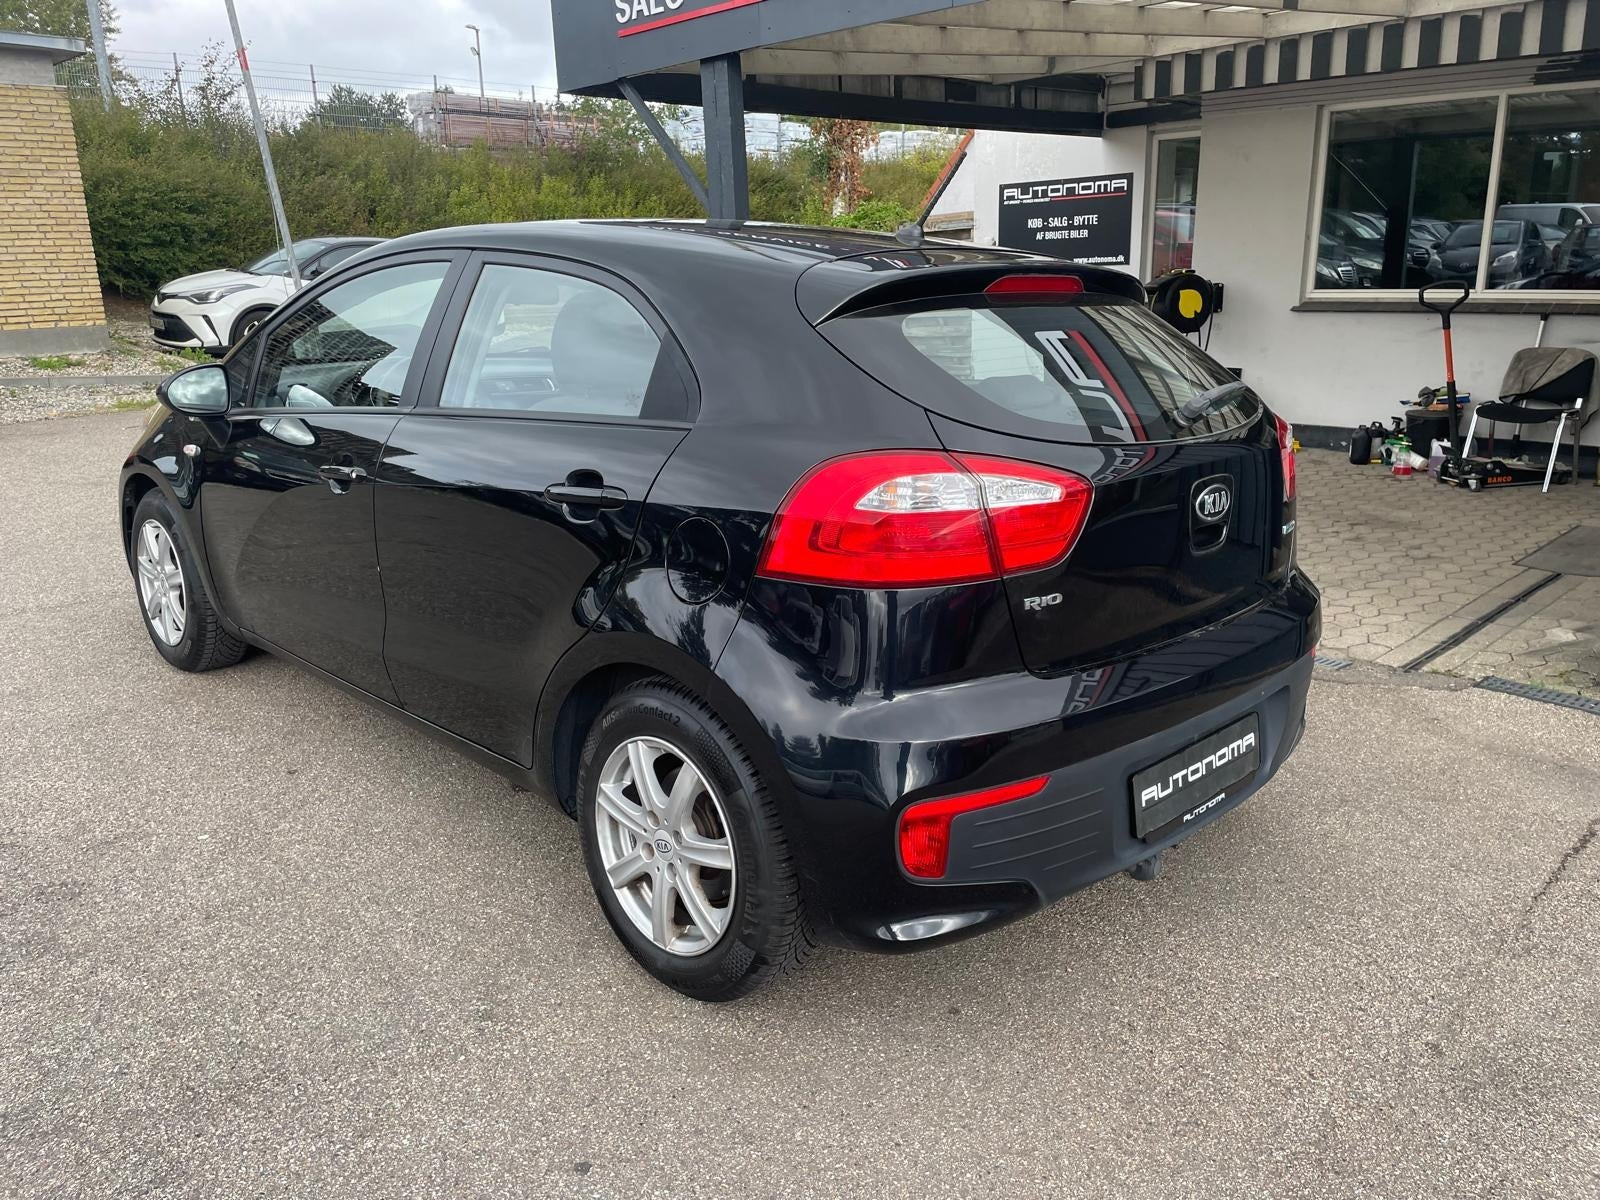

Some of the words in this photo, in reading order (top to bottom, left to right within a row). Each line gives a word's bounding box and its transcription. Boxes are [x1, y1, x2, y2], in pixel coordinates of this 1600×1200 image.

[1003, 179, 1128, 201] AUTONOMA
[1027, 218, 1043, 229] KØB
[1048, 216, 1068, 228] SALG
[1073, 214, 1099, 226] BYTTE
[1036, 231, 1045, 240] AF
[1045, 230, 1070, 240] BRUGTE
[1070, 229, 1089, 239] BILER
[1203, 490, 1228, 515] KIA
[1023, 592, 1063, 611] RIO
[1141, 731, 1255, 808] AUTONOMA
[1183, 792, 1226, 823] AUTONOMA
[656, 841, 669, 851] KIA
